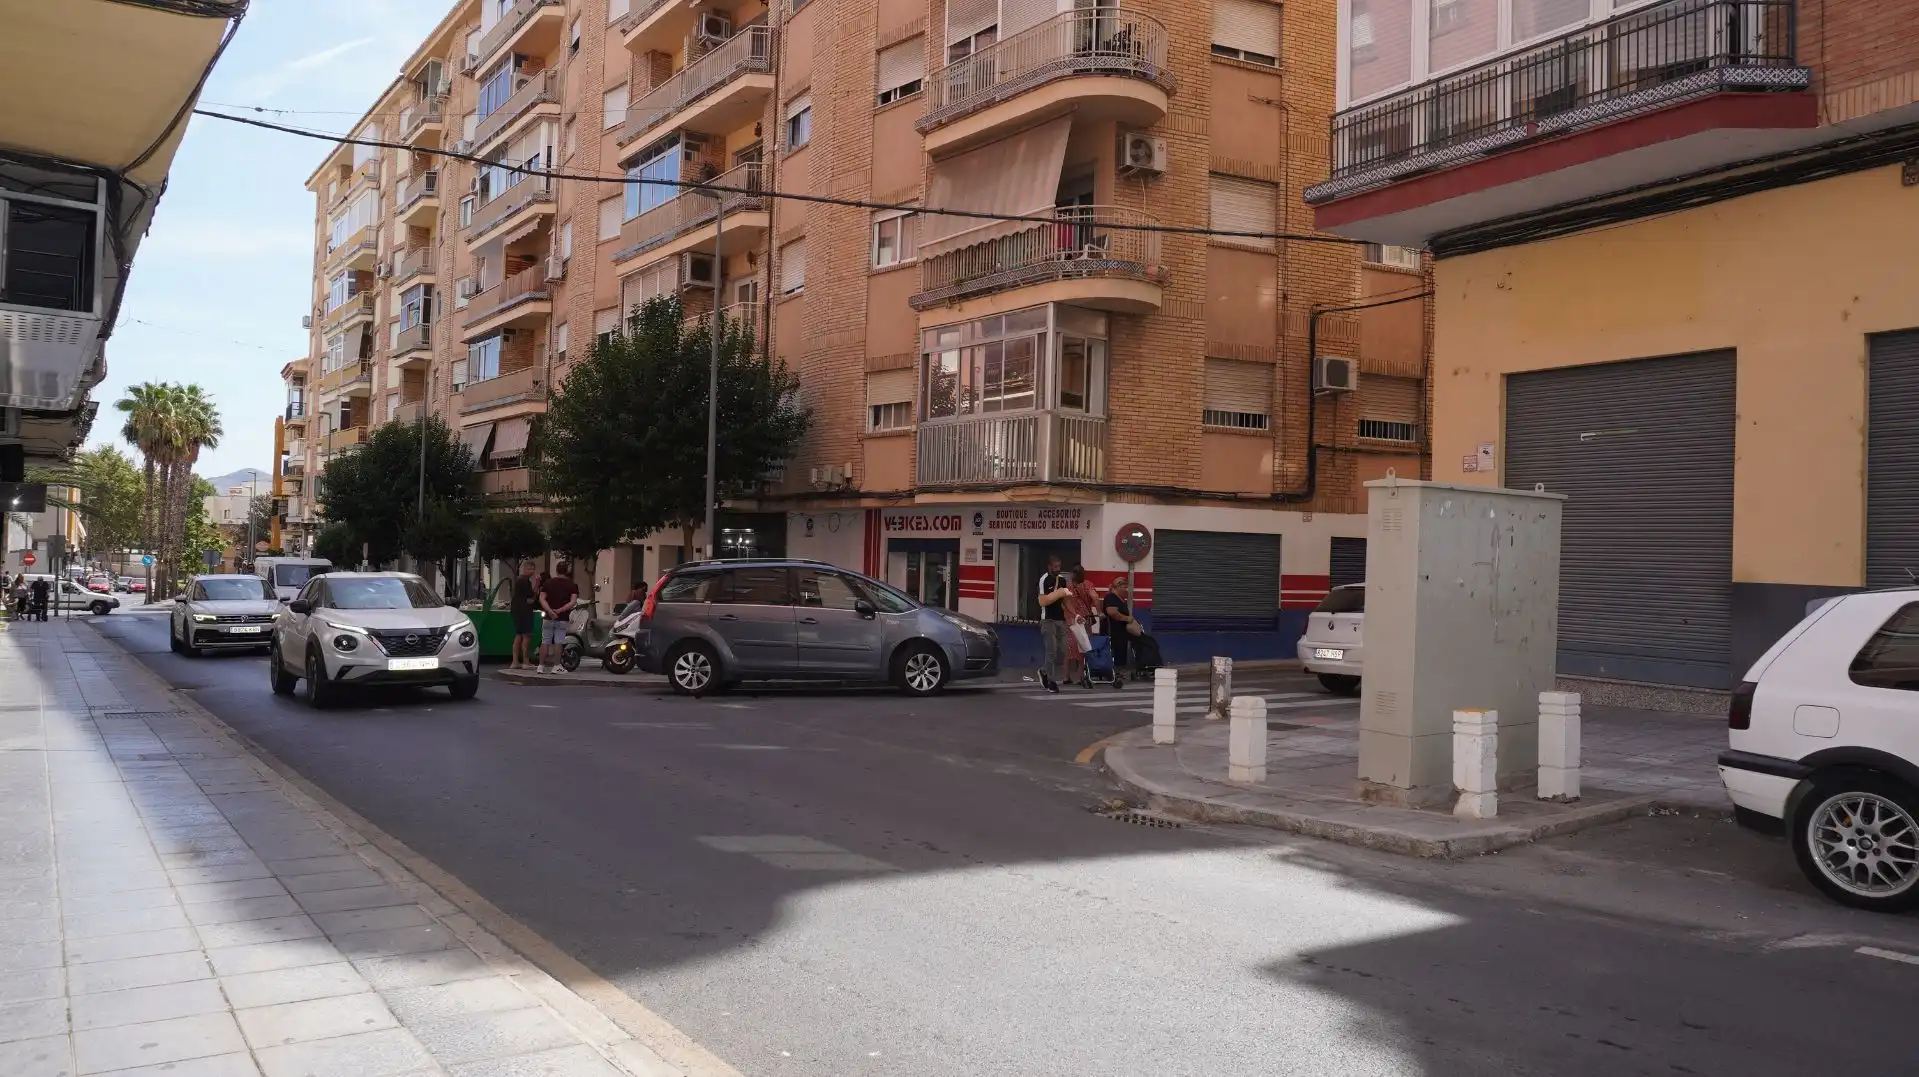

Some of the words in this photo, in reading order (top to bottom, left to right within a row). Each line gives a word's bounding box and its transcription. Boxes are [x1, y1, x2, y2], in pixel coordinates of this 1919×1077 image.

[996, 509, 1028, 519] BOUTIQUE
[1038, 508, 1081, 519] ACCESORIOS
[988, 520, 1017, 529] SERVICIO
[1019, 520, 1047, 529] TECNICO
